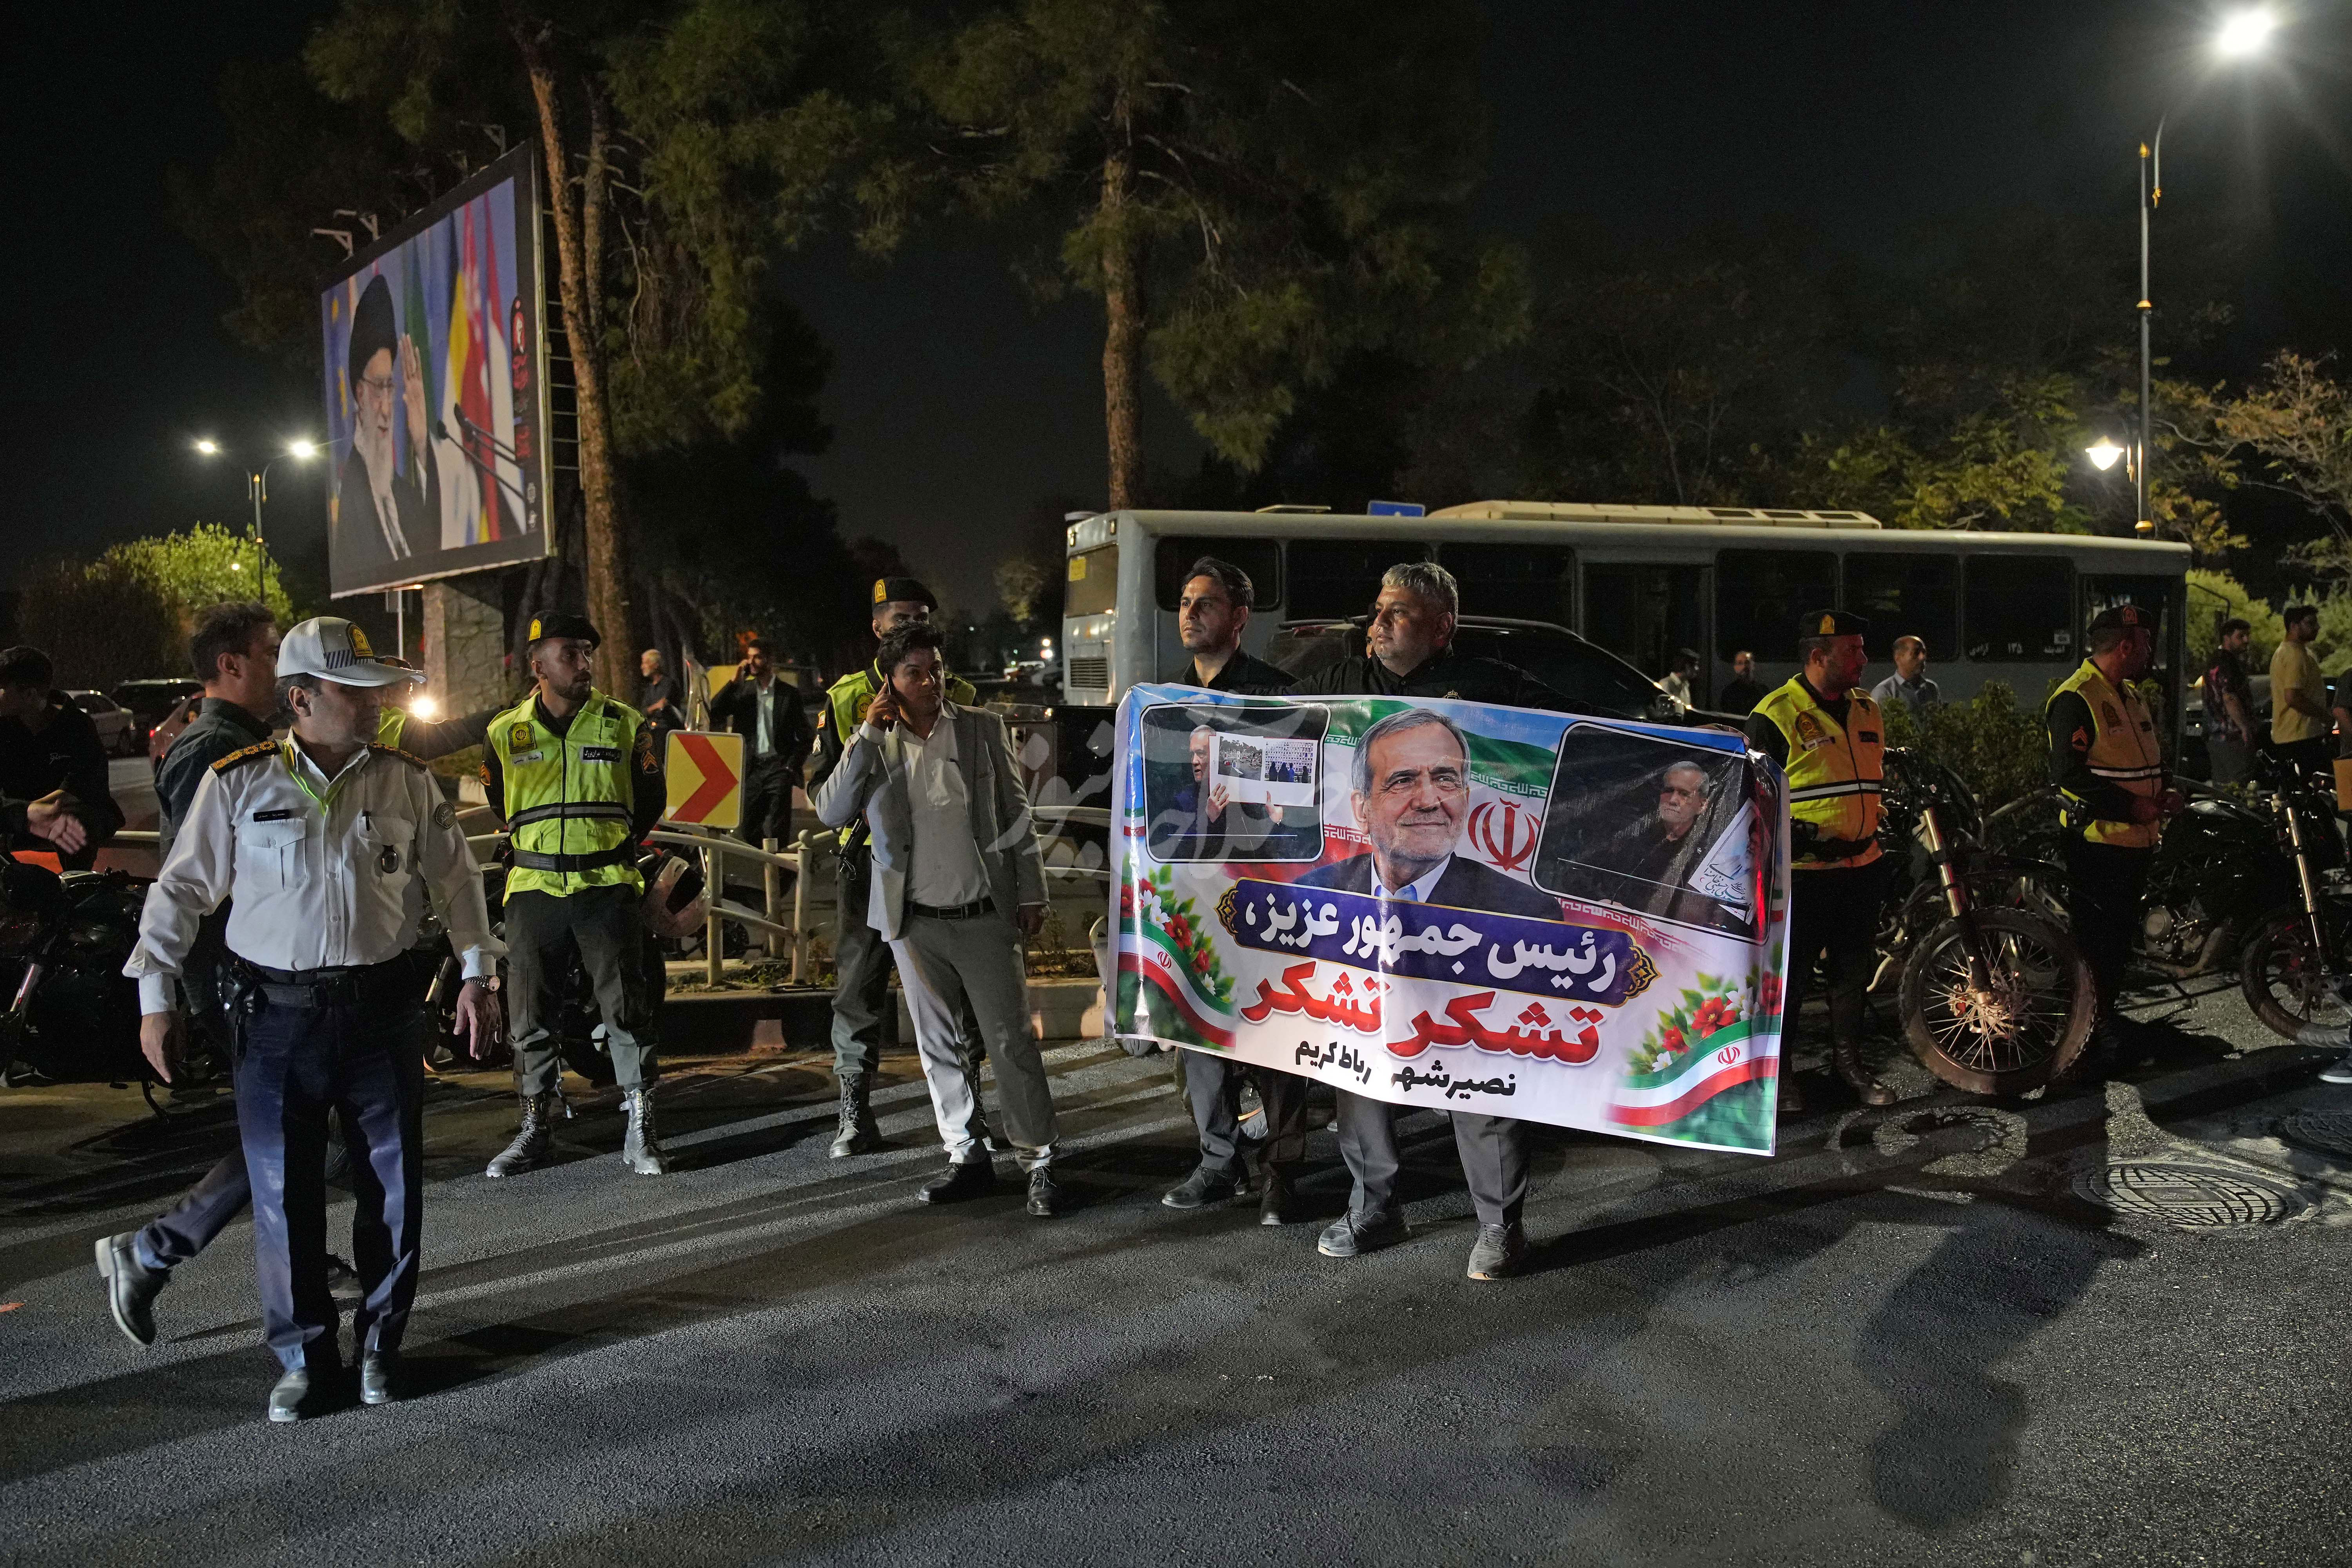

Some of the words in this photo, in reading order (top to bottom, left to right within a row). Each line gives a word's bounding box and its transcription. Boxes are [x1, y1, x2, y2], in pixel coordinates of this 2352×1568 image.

[1342, 914, 1483, 975] جمهور
[1487, 931, 1616, 992] رئیس
[1241, 961, 1390, 1033] تشکر
[1386, 991, 1604, 1063] تشکر
[1296, 1041, 1338, 1070] کریم
[1338, 1045, 1372, 1085] رباط
[1391, 1060, 1516, 1100] نصیرشه
